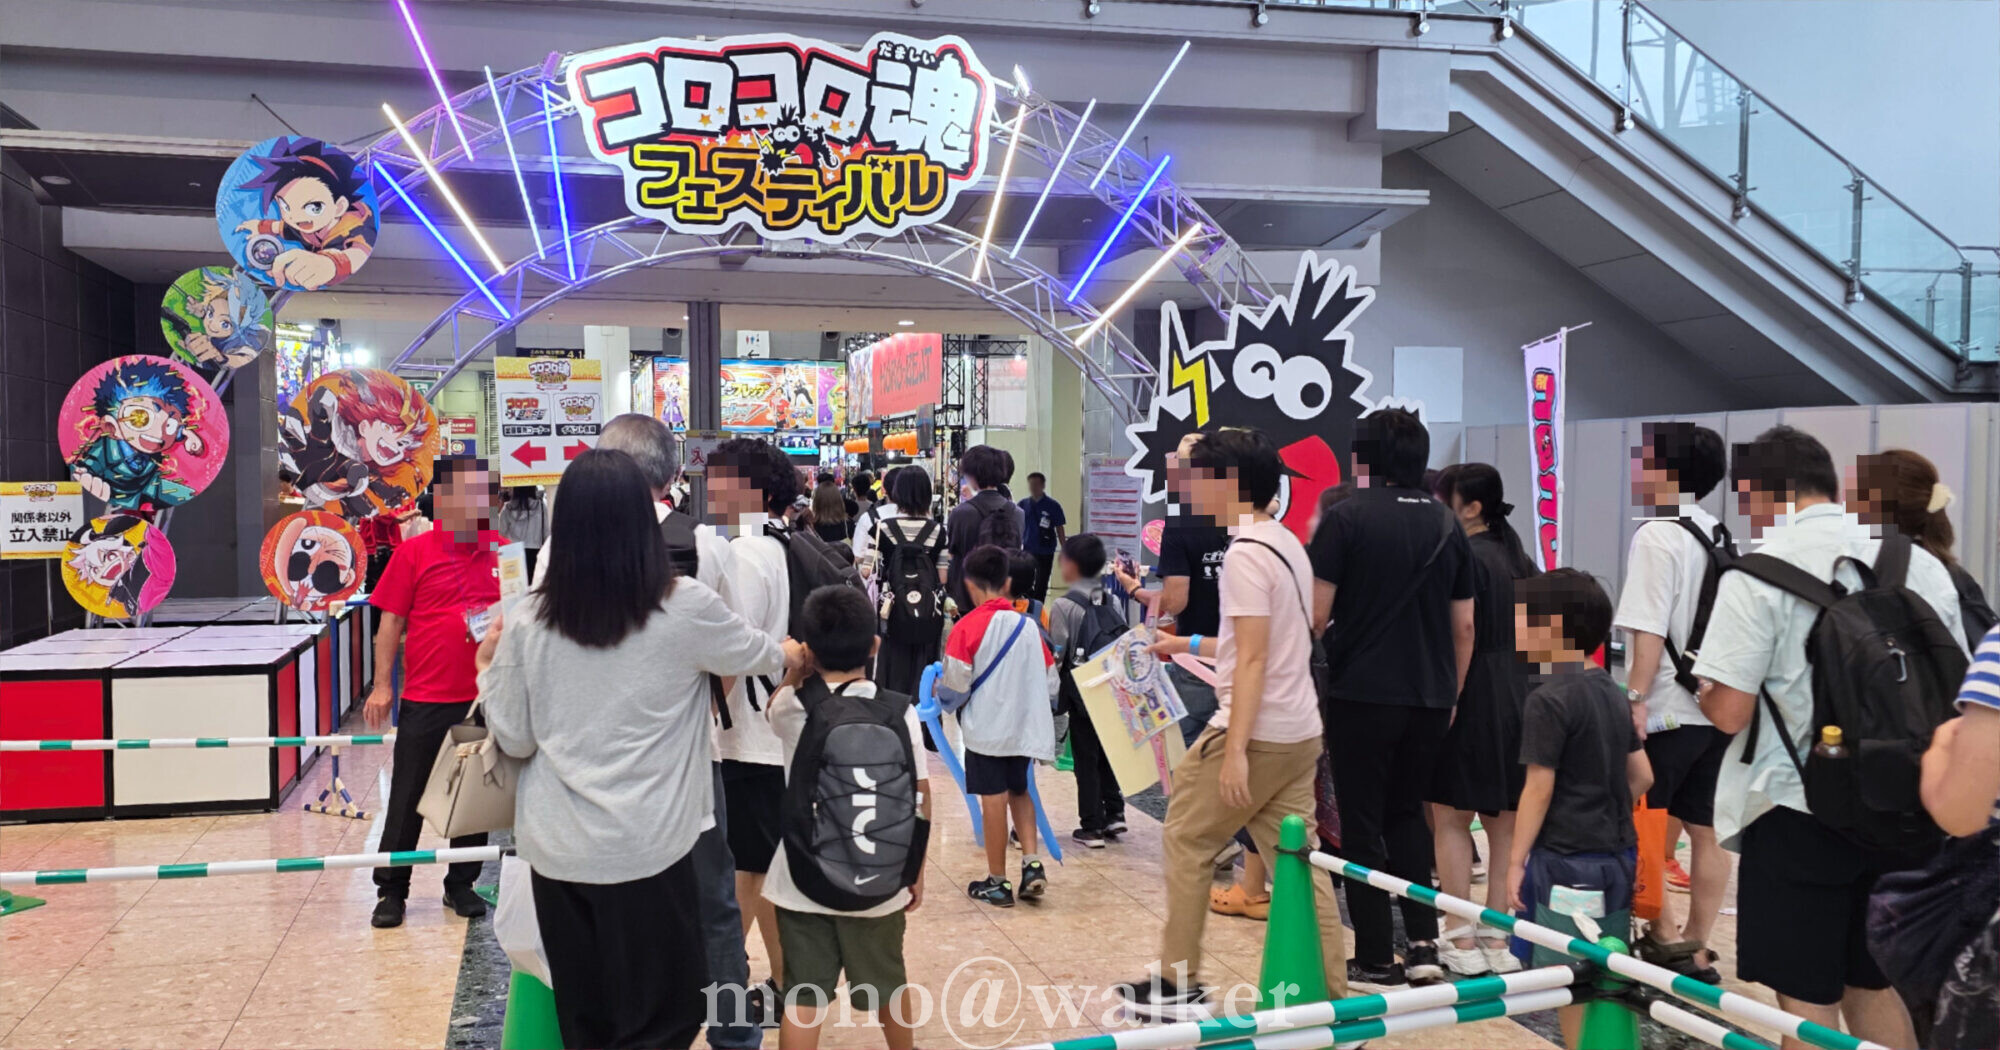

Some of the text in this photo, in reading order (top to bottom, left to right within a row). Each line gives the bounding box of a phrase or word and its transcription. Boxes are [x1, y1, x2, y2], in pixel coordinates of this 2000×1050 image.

[878, 42, 937, 65] だましい
[584, 51, 980, 165] コロコロ魂
[633, 145, 949, 230] フェスティバル
[11, 512, 72, 524] 関係者以外
[10, 527, 73, 543] 立入禁止
